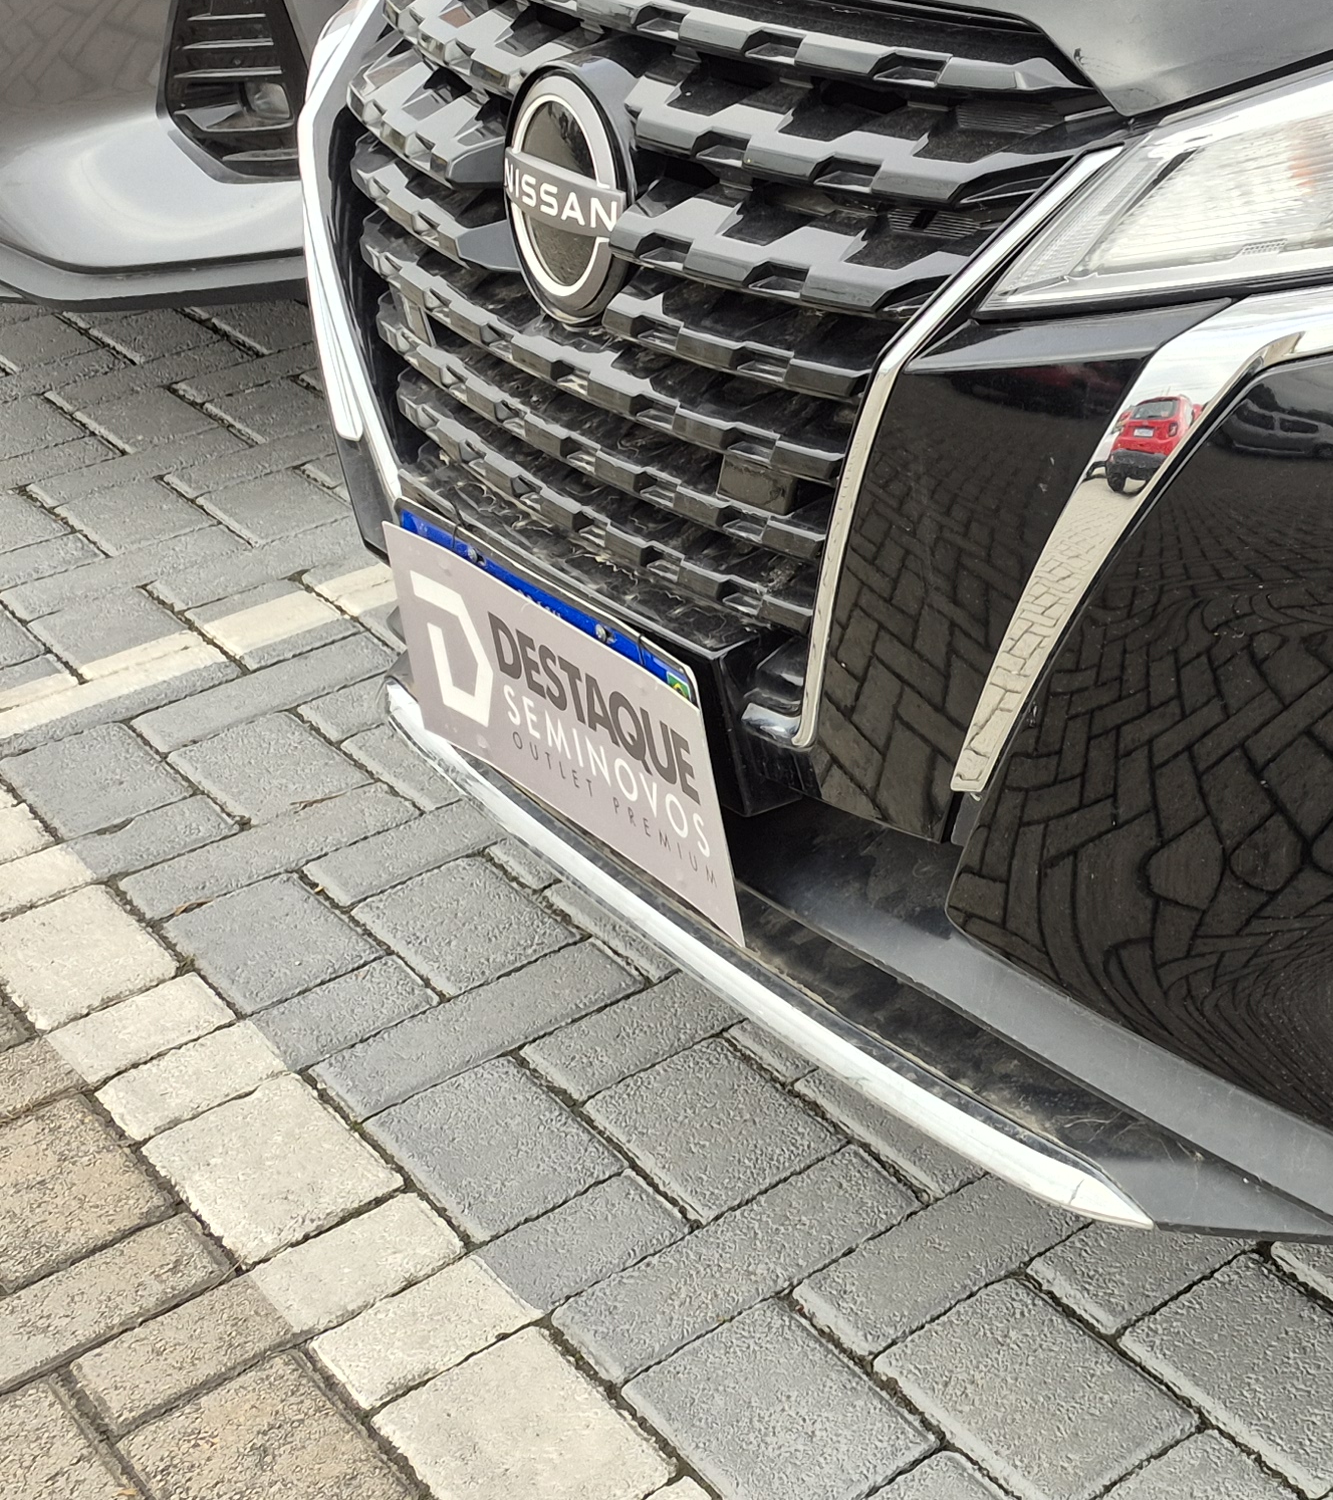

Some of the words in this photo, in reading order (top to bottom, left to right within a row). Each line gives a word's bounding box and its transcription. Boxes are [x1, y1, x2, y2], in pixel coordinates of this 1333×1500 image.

[503, 156, 618, 233] NISSAN
[488, 610, 701, 807] DESTAQUE
[503, 684, 711, 859] SEMINOVOS
[512, 731, 594, 798] OUTLET
[612, 796, 718, 889] PREMIUM
